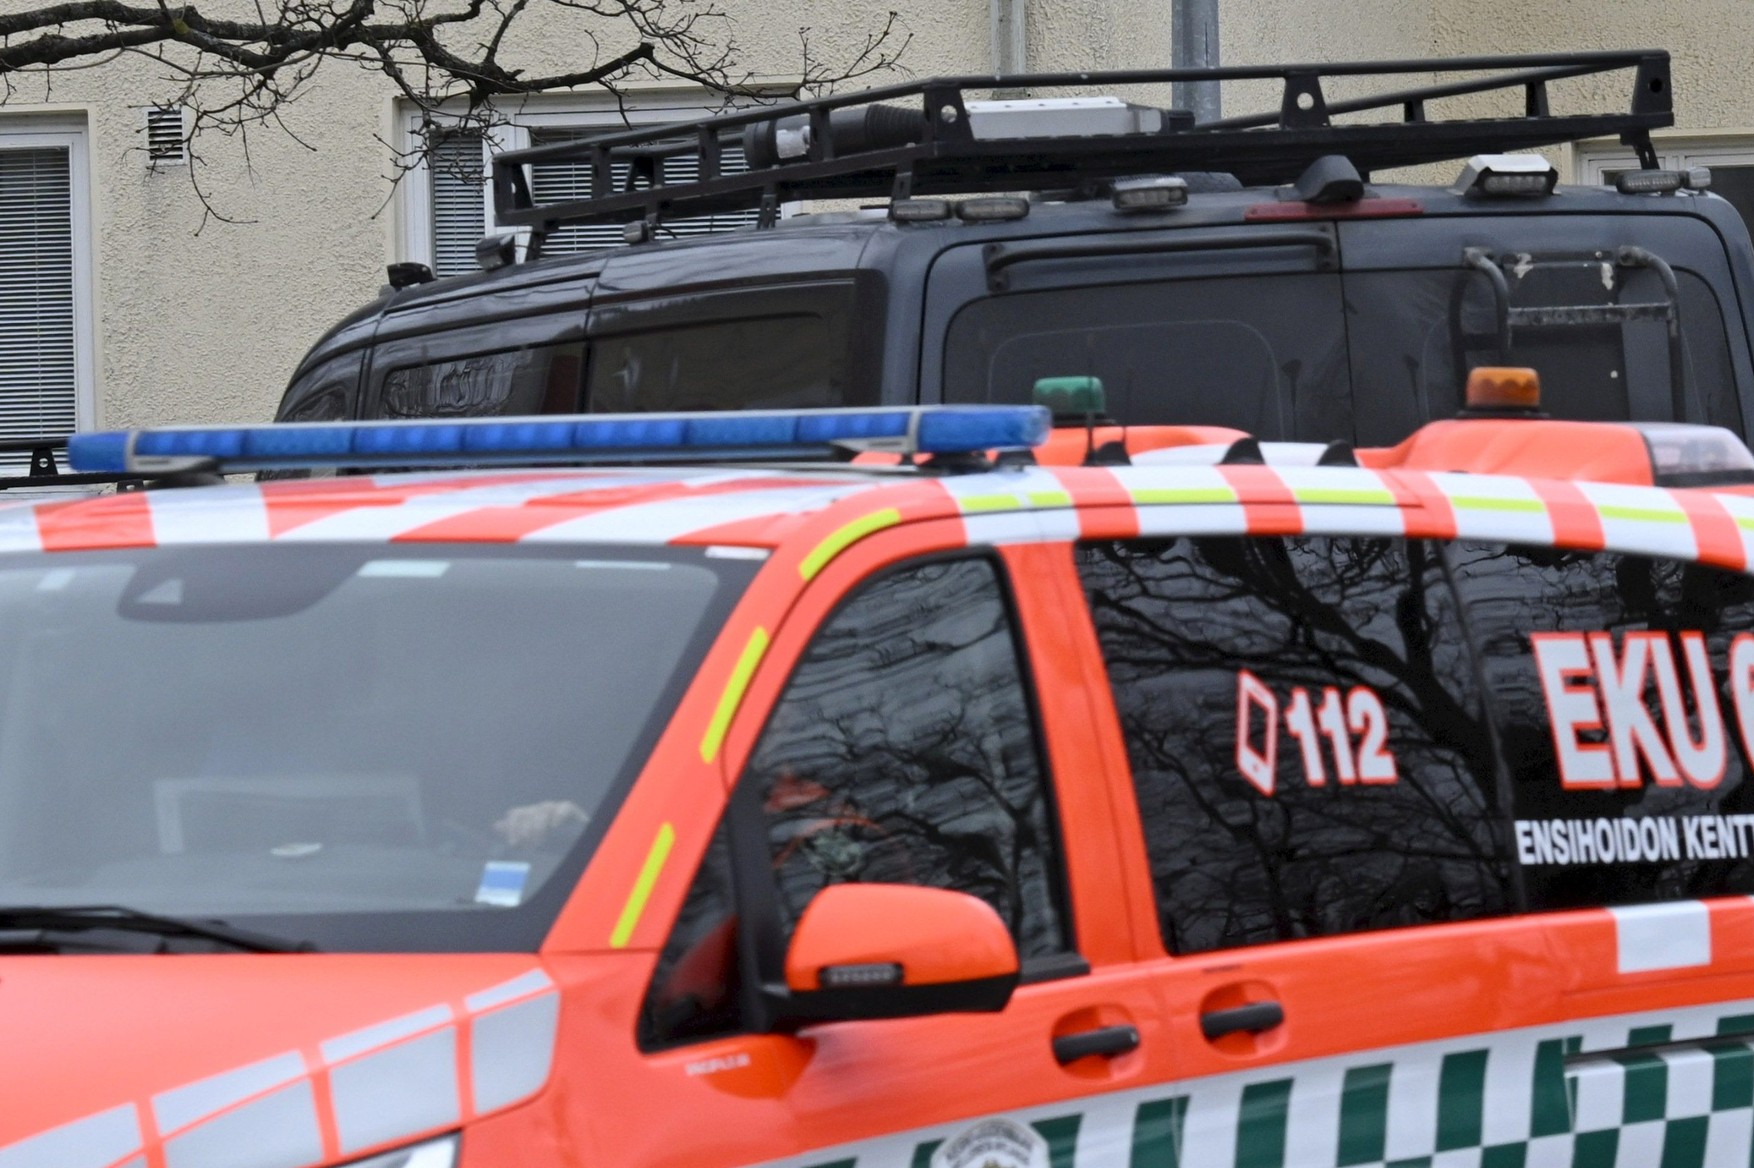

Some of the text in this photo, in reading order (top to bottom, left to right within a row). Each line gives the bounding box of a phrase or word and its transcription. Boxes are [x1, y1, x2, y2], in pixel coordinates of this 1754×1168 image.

[1285, 685, 1399, 788] 112
[1529, 629, 1727, 790] EKU
[1514, 817, 1681, 865] ENSIHOIDON
